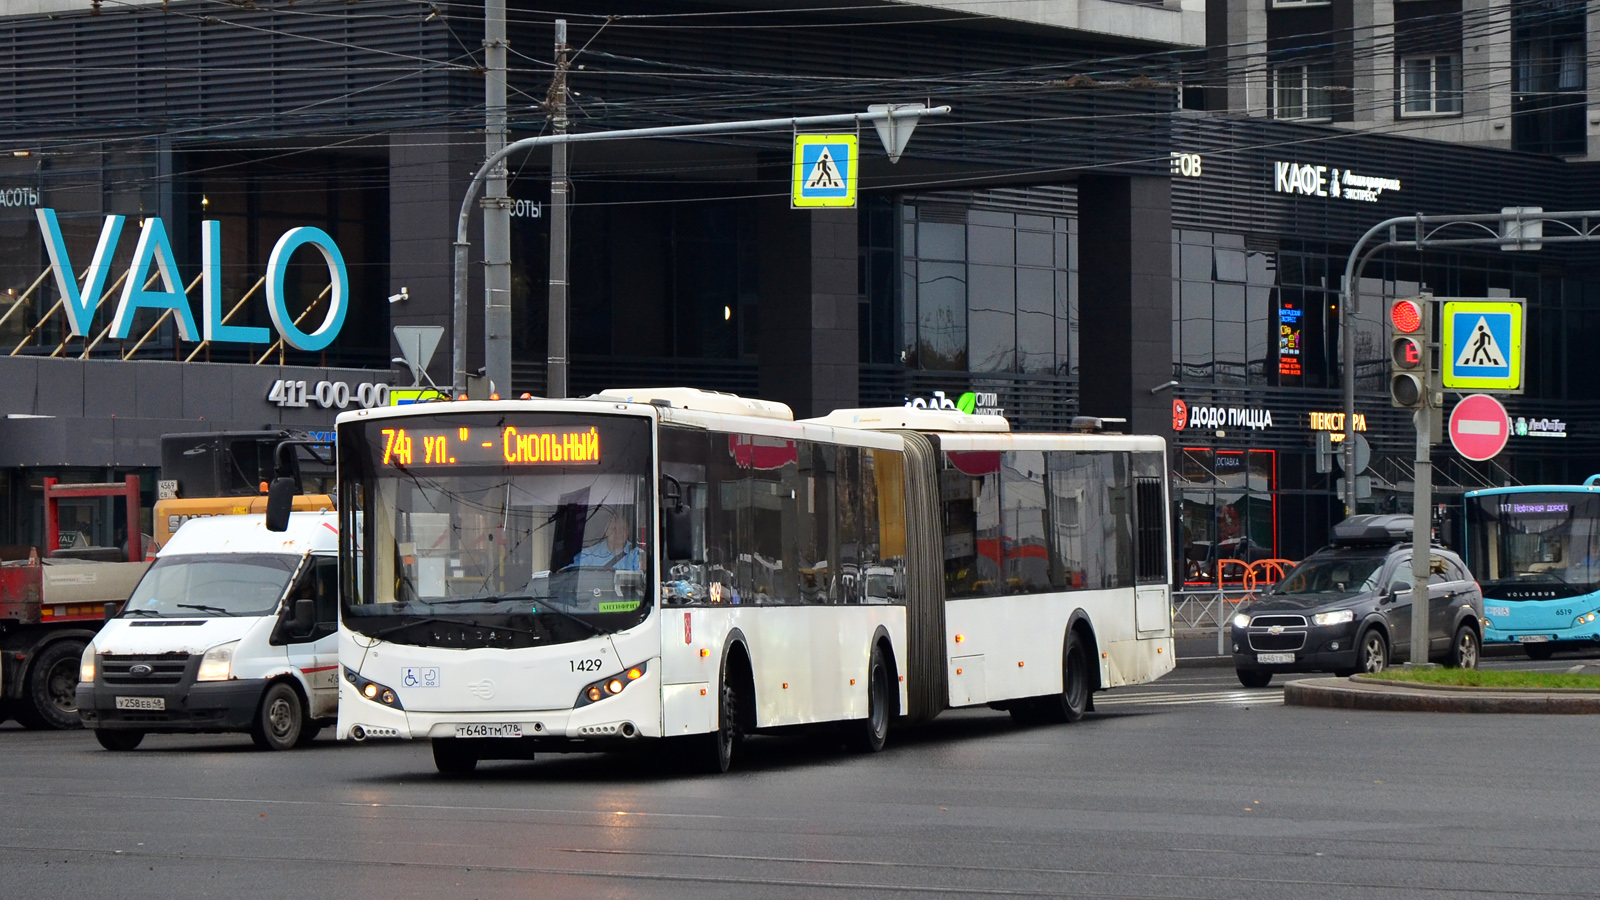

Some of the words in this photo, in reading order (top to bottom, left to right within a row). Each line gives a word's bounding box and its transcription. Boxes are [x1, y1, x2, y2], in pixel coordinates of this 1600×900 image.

[1275, 161, 1327, 197] КАФЕ
[1343, 188, 1378, 202] ЭКСПРЕСС
[35, 207, 349, 351] VALO
[268, 379, 390, 409] 411-00-00
[975, 392, 998, 406] СИТИ
[1190, 407, 1226, 428] ДОДО
[1228, 407, 1273, 430] ПИЦЦА
[1309, 411, 1367, 431] ТЕКСТРА
[504, 426, 599, 462] Смольный
[1500, 504, 1511, 512] 117
[569, 660, 602, 673] 1429
[460, 725, 502, 736] Т648ТМ
[503, 724, 518, 732] 178
